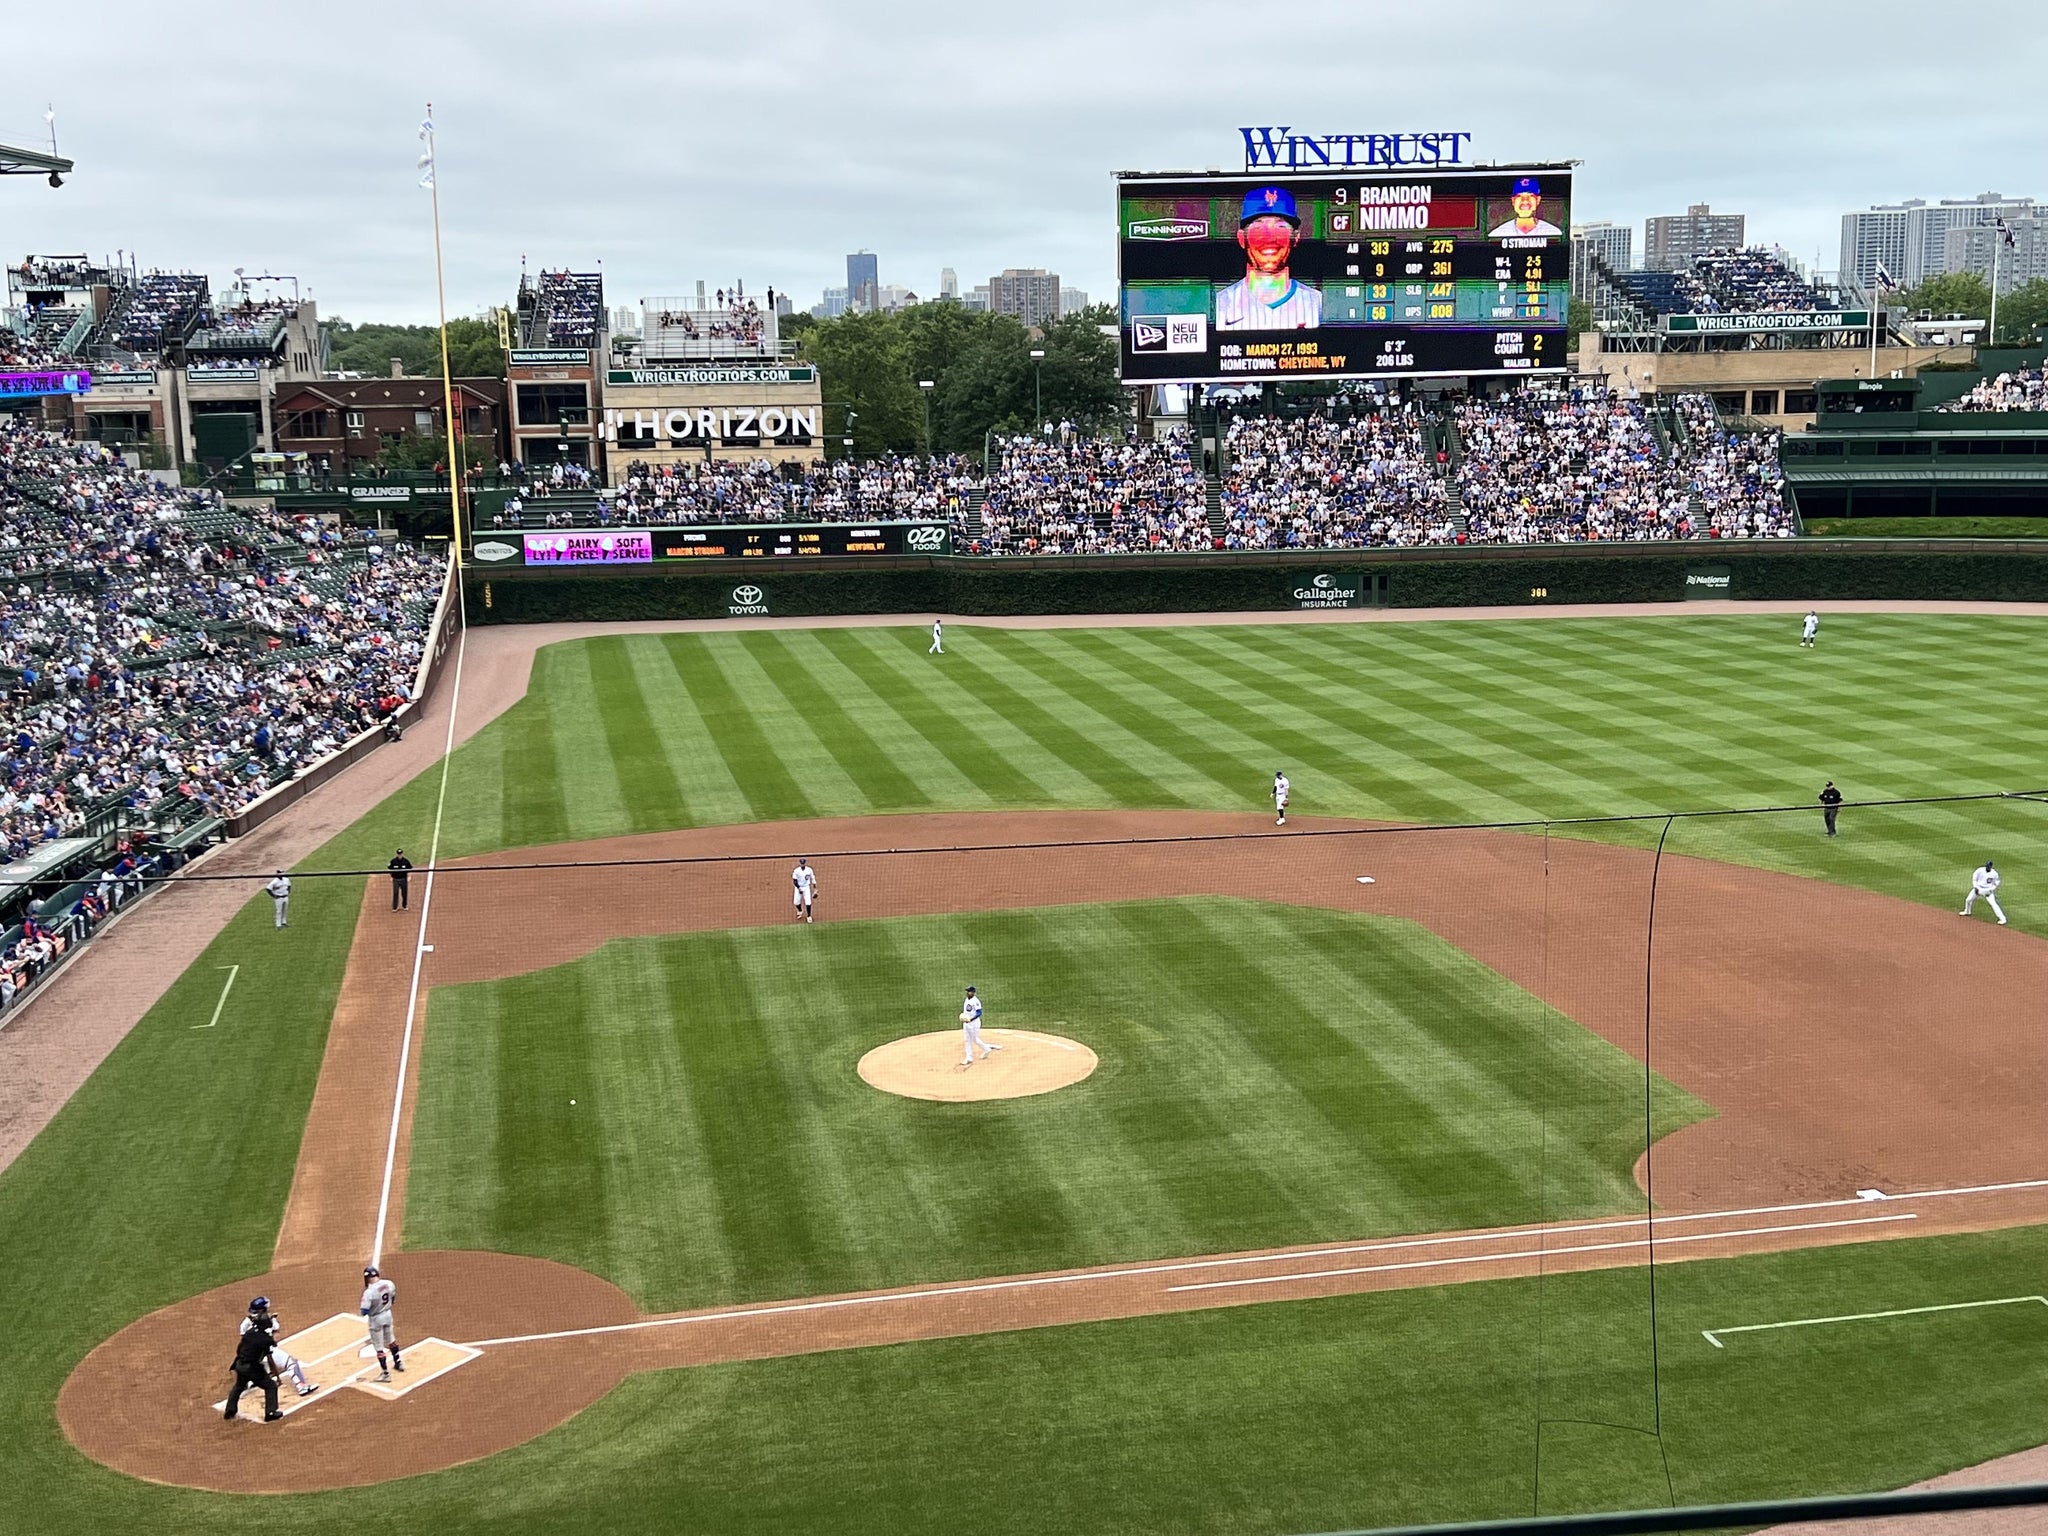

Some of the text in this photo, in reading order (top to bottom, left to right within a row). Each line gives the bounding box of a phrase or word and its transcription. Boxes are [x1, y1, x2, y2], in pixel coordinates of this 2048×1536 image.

[1238, 127, 1471, 168] WINTRUST
[1335, 187, 1347, 205] 9
[1360, 185, 1431, 205] BRANDON
[1333, 215, 1349, 230] CF
[1360, 205, 1428, 230] NIMMO
[1133, 225, 1204, 235] PENNINGTON
[1347, 240, 1454, 255] AB 313 AVG .275
[1526, 255, 1541, 267] 2-5
[1346, 261, 1452, 277] HR 9 OBP .361
[1495, 269, 1511, 280] ERA
[1405, 285, 1422, 296] SLG
[1429, 283, 1452, 297] .447
[1405, 307, 1422, 317] OPS
[1491, 307, 1513, 318] WHIP
[1696, 313, 1842, 329] WRIGLEYROOFTOPS.COM
[1172, 322, 1198, 334] NEW
[1172, 333, 1198, 344] ERA
[1496, 332, 1543, 351] PITCH 2
[1220, 342, 1318, 357] DOB: MARCH 27, 1993
[1494, 343, 1524, 355] COUNT
[1220, 356, 1346, 371] HOMETOWN: CHEYENNE, WY
[1375, 353, 1414, 366] 206 LBS
[631, 369, 790, 383] WRIGLEYROOFTOPS.COM
[634, 408, 816, 440] HORIZON
[351, 487, 411, 497] GRAINGER
[907, 526, 946, 544] OZO
[568, 539, 599, 549] DAIRY
[616, 538, 643, 548] SOFT
[912, 543, 941, 551] FOODS
[1293, 587, 1356, 601] Gallagher
[728, 605, 769, 614] TOYOTA
[1301, 600, 1348, 608] INSURANCE
[381, 1293, 389, 1305] 9
